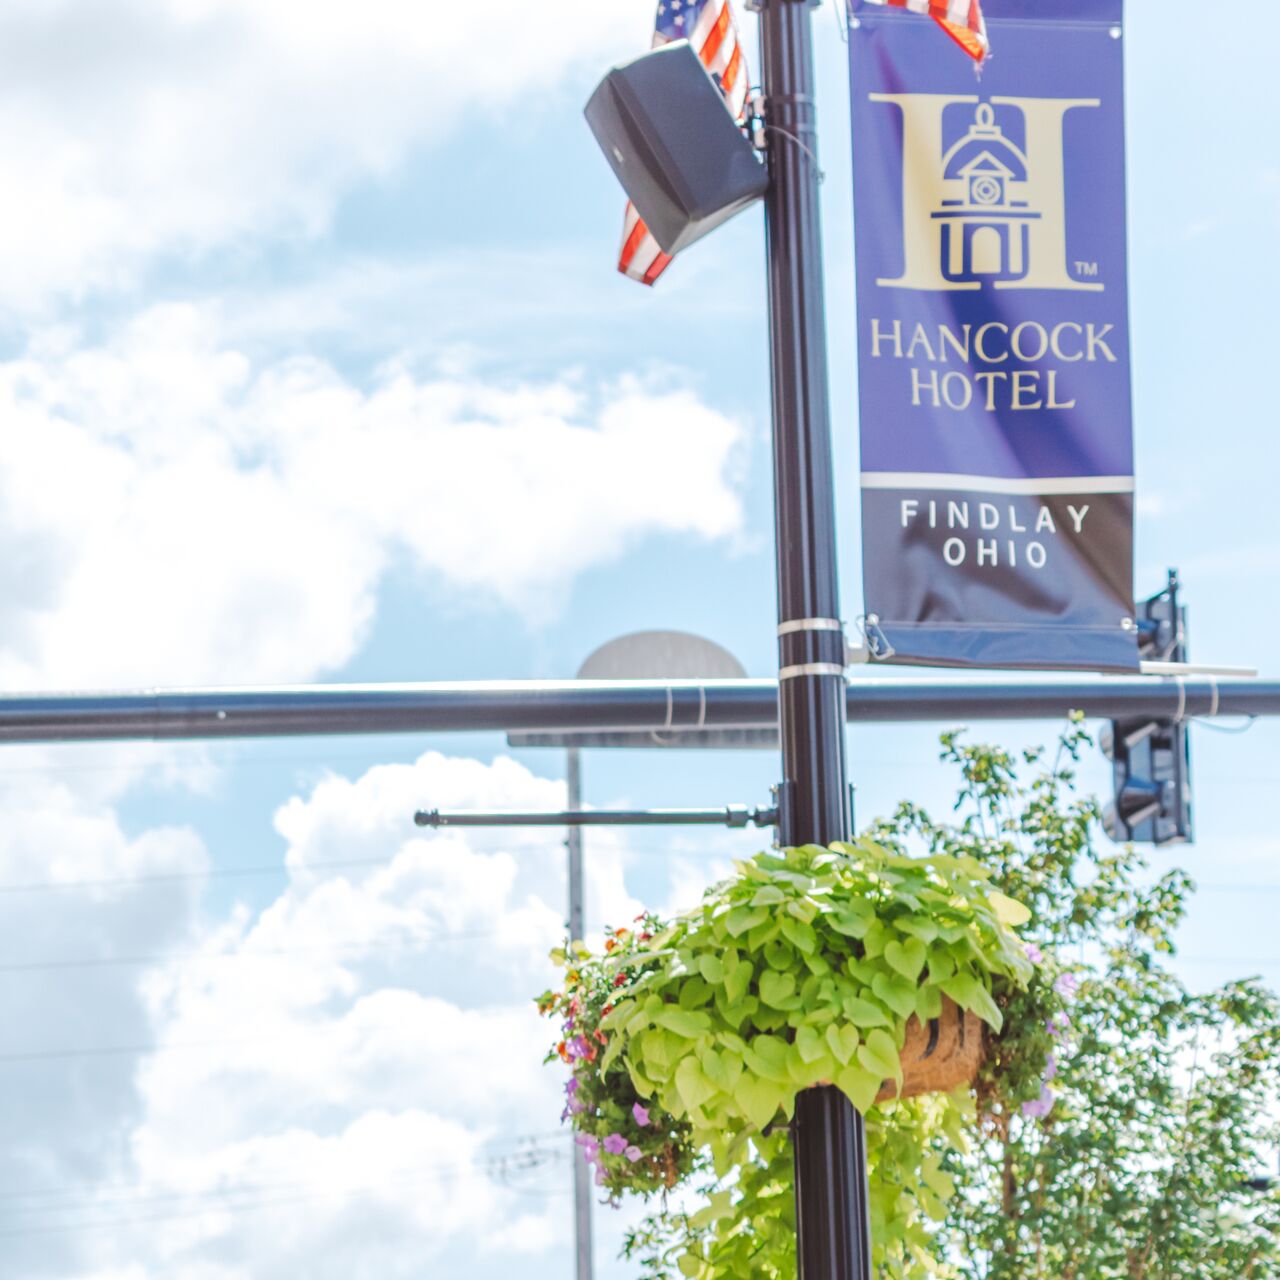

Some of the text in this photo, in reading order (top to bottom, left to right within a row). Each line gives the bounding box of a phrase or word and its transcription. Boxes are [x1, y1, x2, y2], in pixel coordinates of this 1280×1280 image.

[1074, 261, 1098, 276] TM
[870, 318, 1118, 364] HANCOCK
[910, 367, 1076, 412] HOTEL
[900, 499, 1090, 533] FINDLAY
[943, 537, 1047, 569] OHIO
